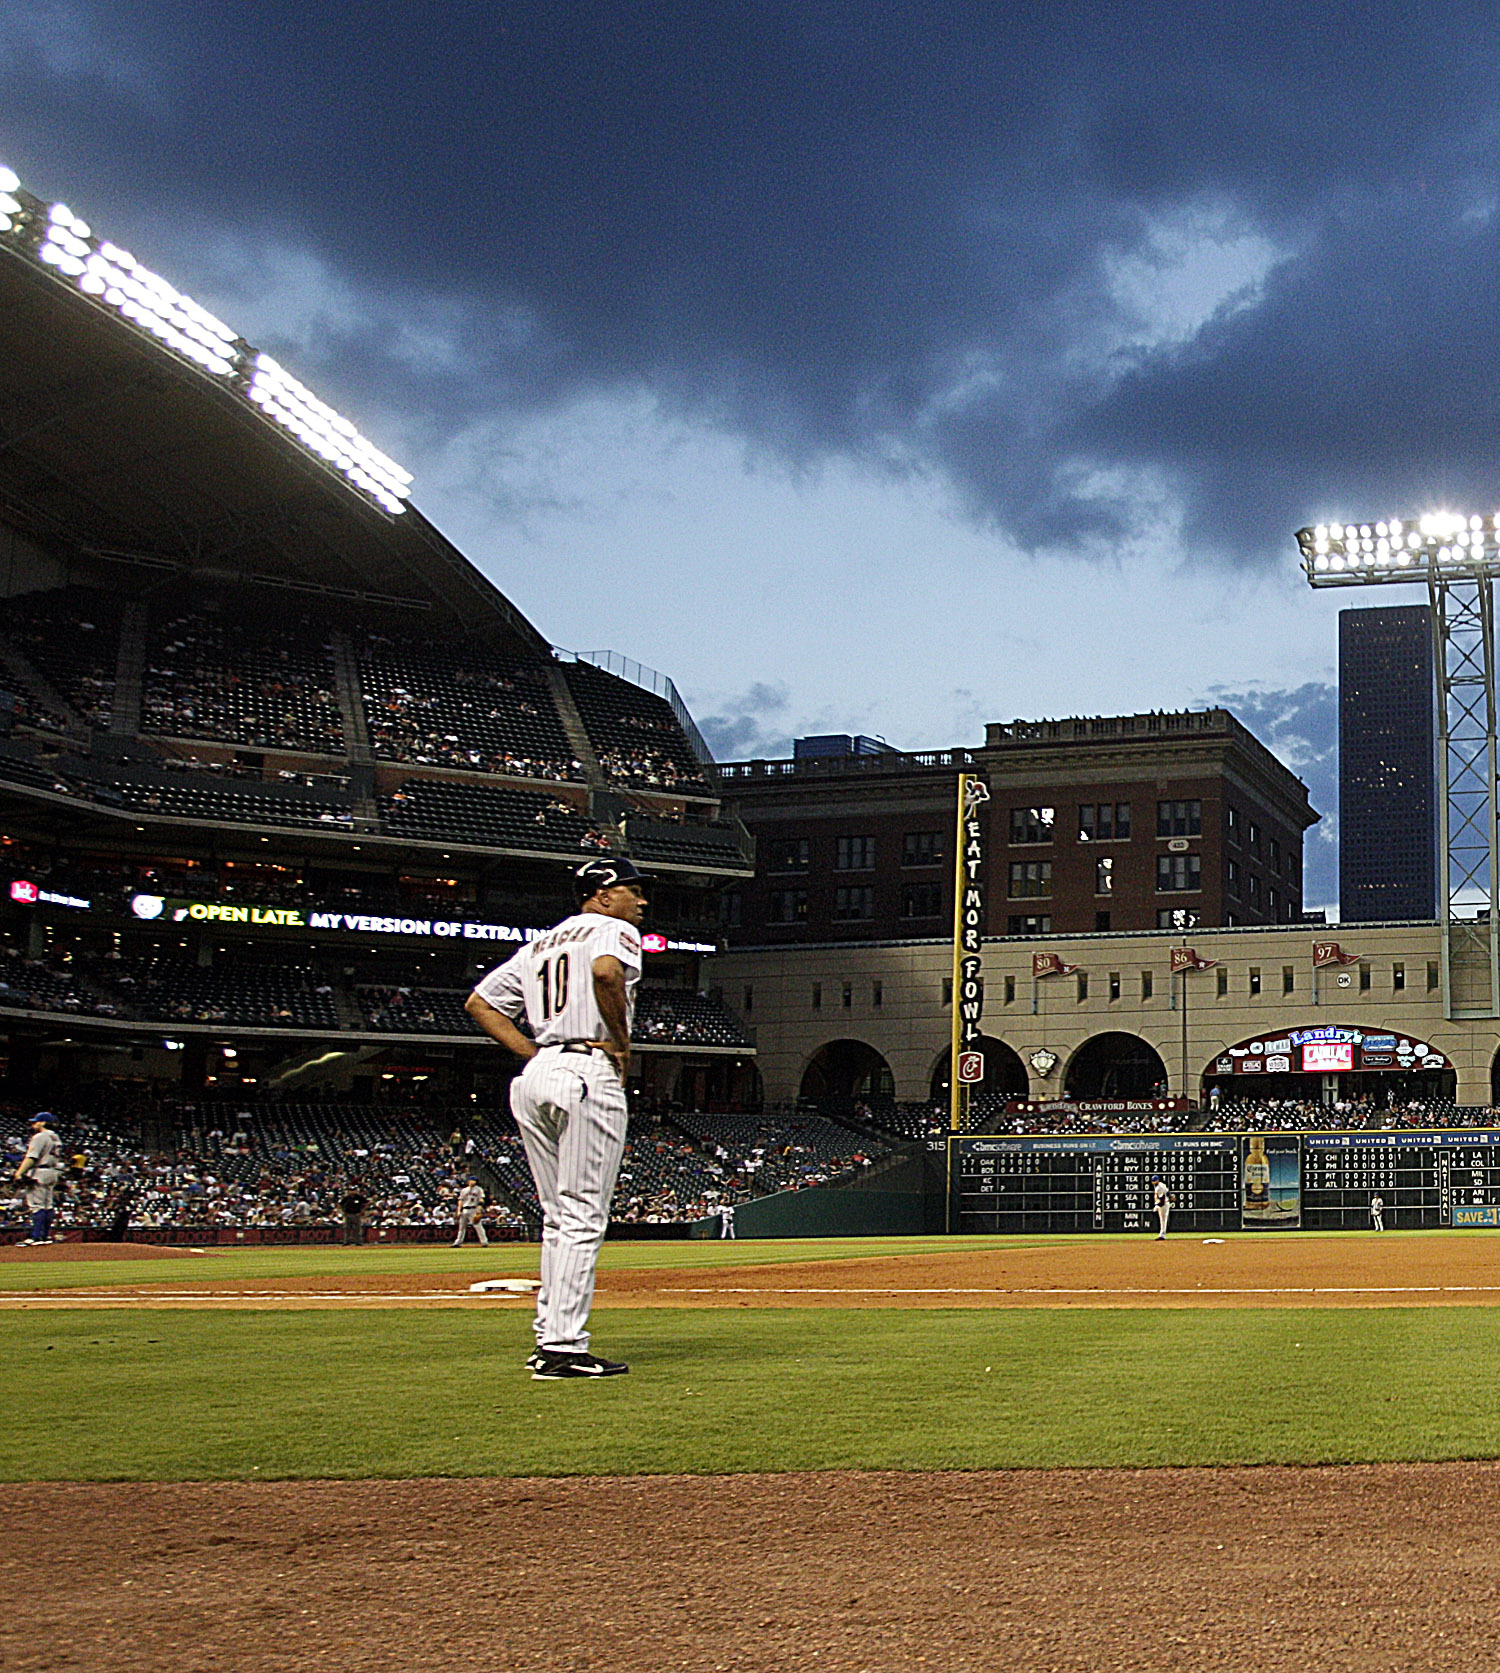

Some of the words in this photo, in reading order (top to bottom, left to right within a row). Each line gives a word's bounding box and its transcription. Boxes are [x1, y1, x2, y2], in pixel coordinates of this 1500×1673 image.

[966, 821, 982, 879] EAT
[190, 904, 248, 922] OPEN
[251, 909, 305, 926] LATE.
[310, 912, 342, 929] MY
[343, 914, 432, 937] VERSION
[434, 921, 463, 938] OF
[465, 924, 524, 943] EXTRA
[966, 889, 982, 949] MOR
[1174, 952, 1188, 965] 86
[1318, 947, 1333, 960] 97
[1037, 957, 1051, 969] 80
[536, 951, 572, 1022] 10
[964, 961, 981, 1042] FOWL
[1288, 1026, 1363, 1048] Landry's
[1079, 1101, 1125, 1111] CRAWFORD
[1127, 1101, 1154, 1110] BOXES
[927, 1141, 946, 1151] 315
[1457, 1213, 1483, 1223] SAVE
